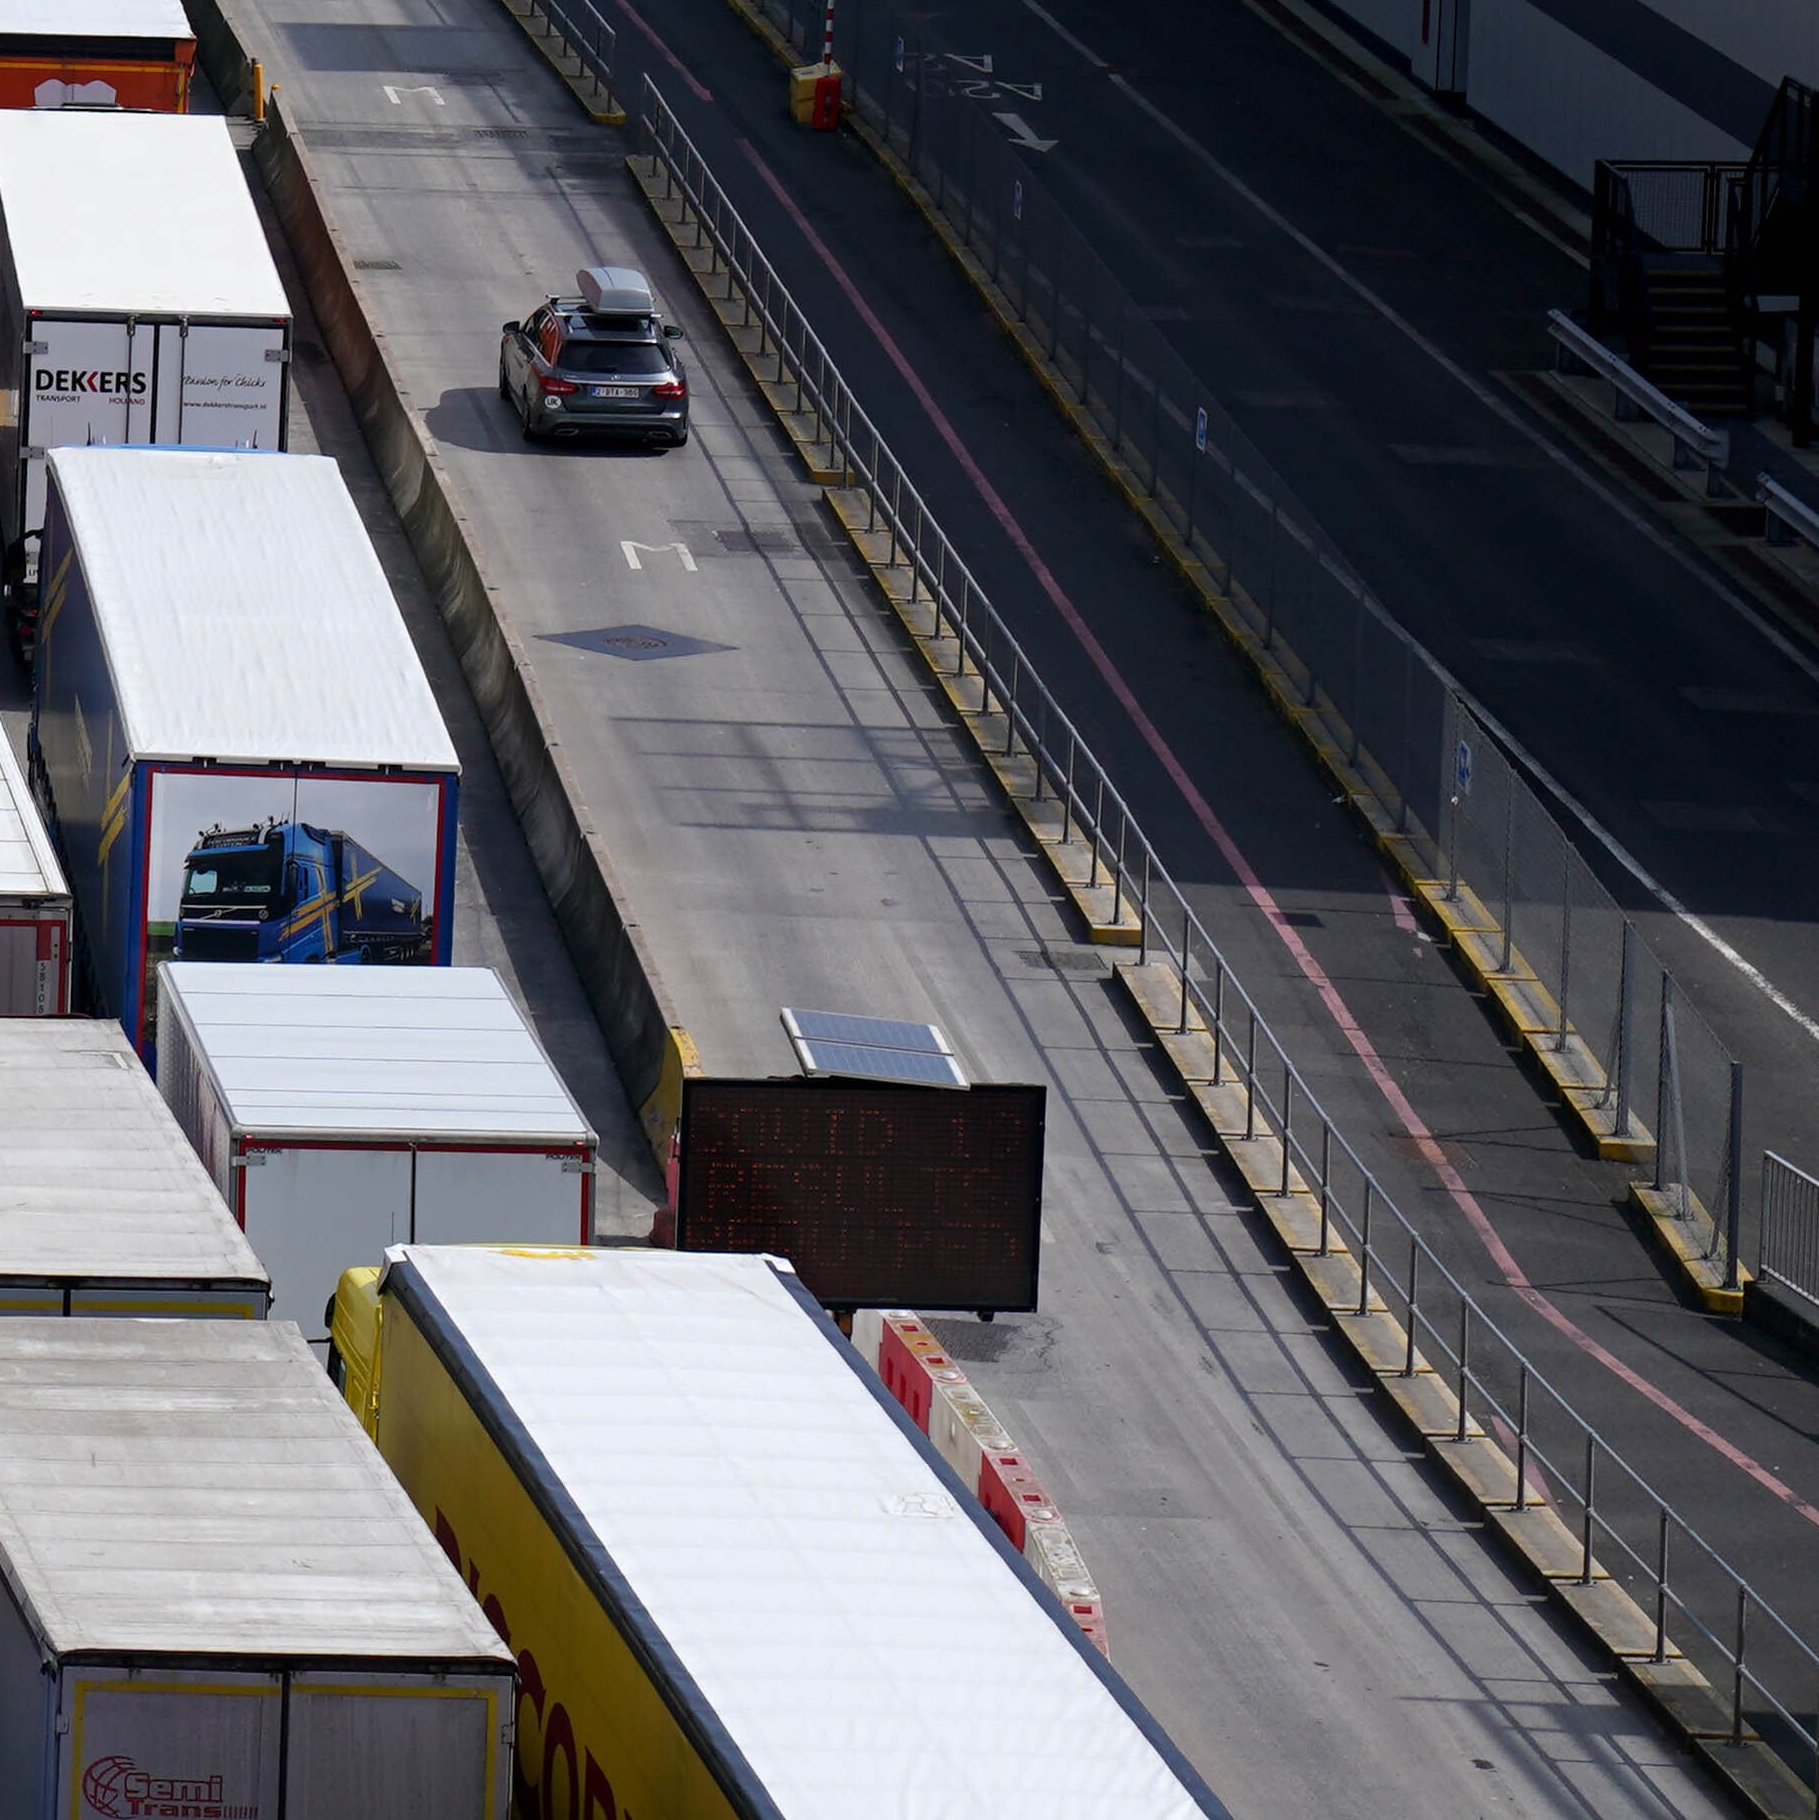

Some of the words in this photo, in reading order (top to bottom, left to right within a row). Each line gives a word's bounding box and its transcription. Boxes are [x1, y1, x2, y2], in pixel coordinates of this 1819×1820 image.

[36, 395, 81, 403] TRANSPORT
[108, 397, 146, 406] HOLLAND
[124, 1772, 223, 1802] Semi
[126, 1799, 223, 1819] Trans
